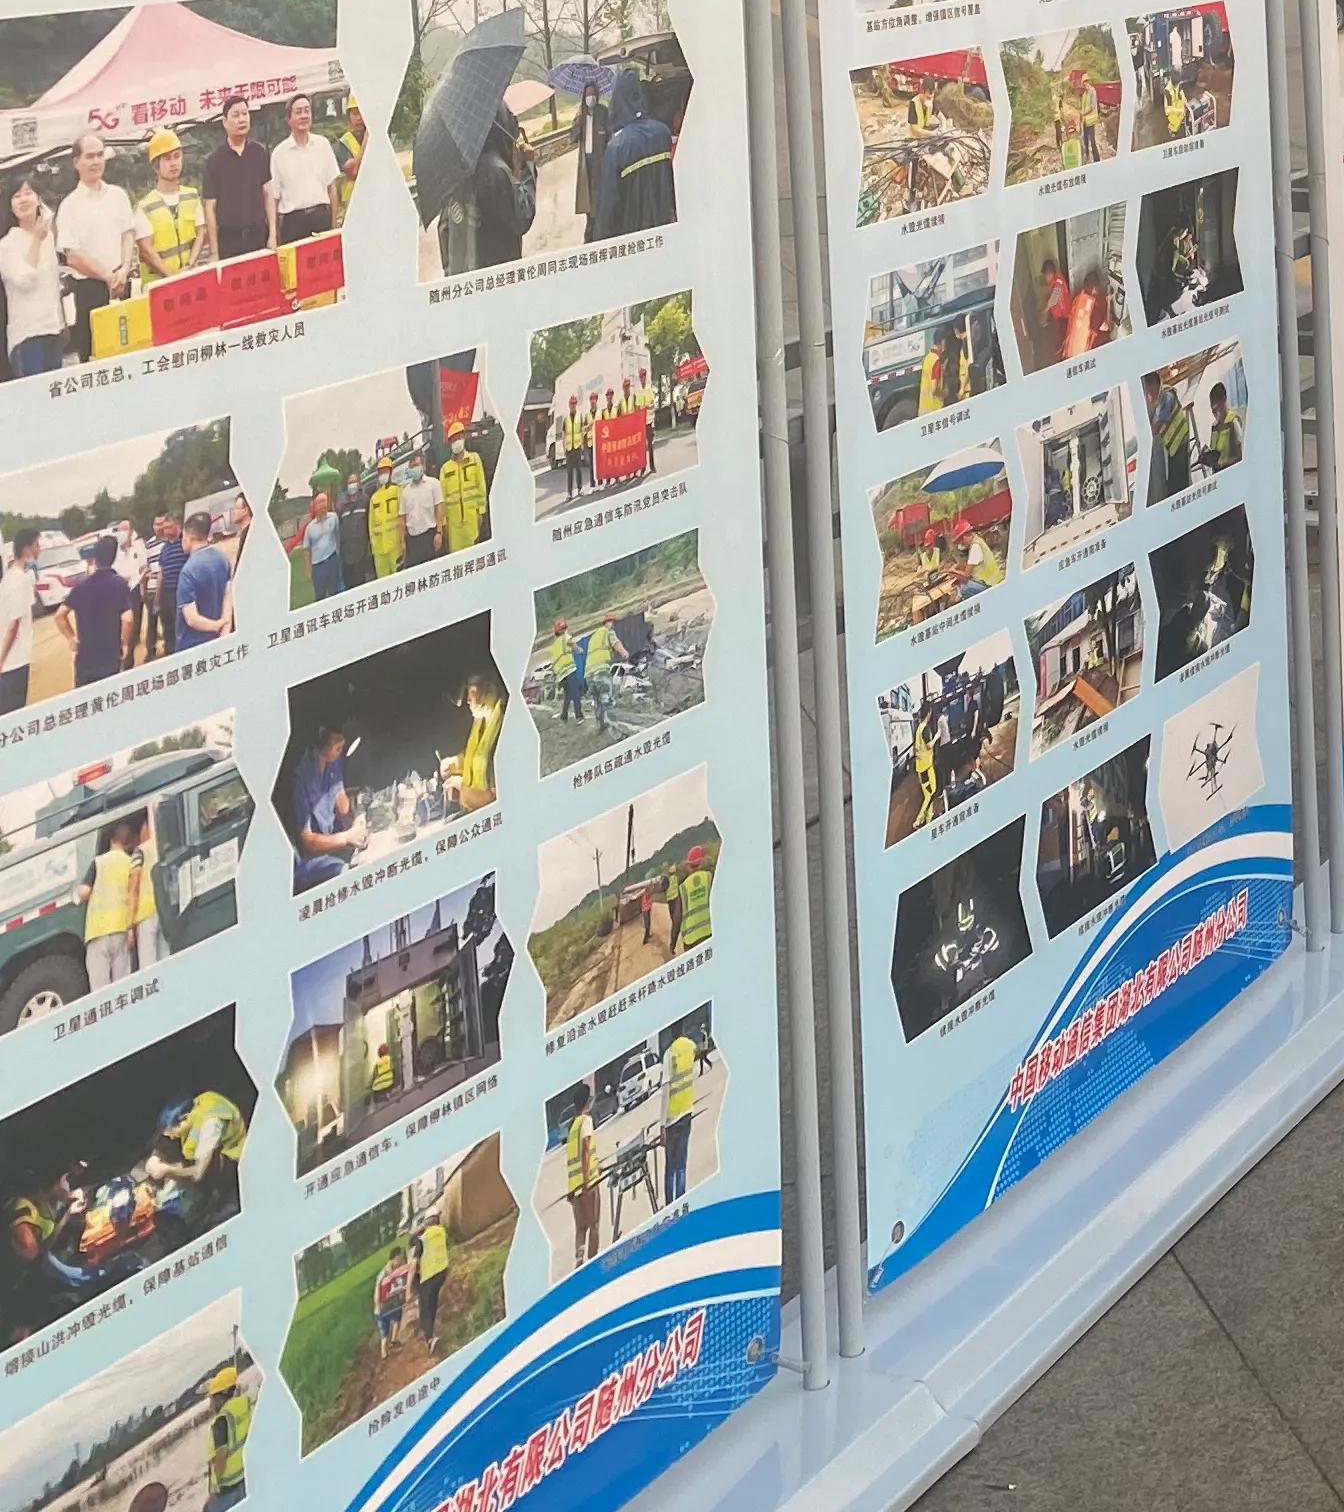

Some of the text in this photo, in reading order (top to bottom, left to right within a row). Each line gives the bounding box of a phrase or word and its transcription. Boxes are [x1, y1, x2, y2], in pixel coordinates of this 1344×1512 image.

[131, 97, 187, 126] 看移动
[49, 321, 306, 399] 省公司范总，工会慰问柳林一线救灾人员
[53, 978, 161, 1042] 卫星通讯车调试
[1009, 888, 1249, 1113] 中国移动通信集团湖北有限公司随州分公司
[432, 1308, 706, 1512] 湖北有限公司随州分公司
